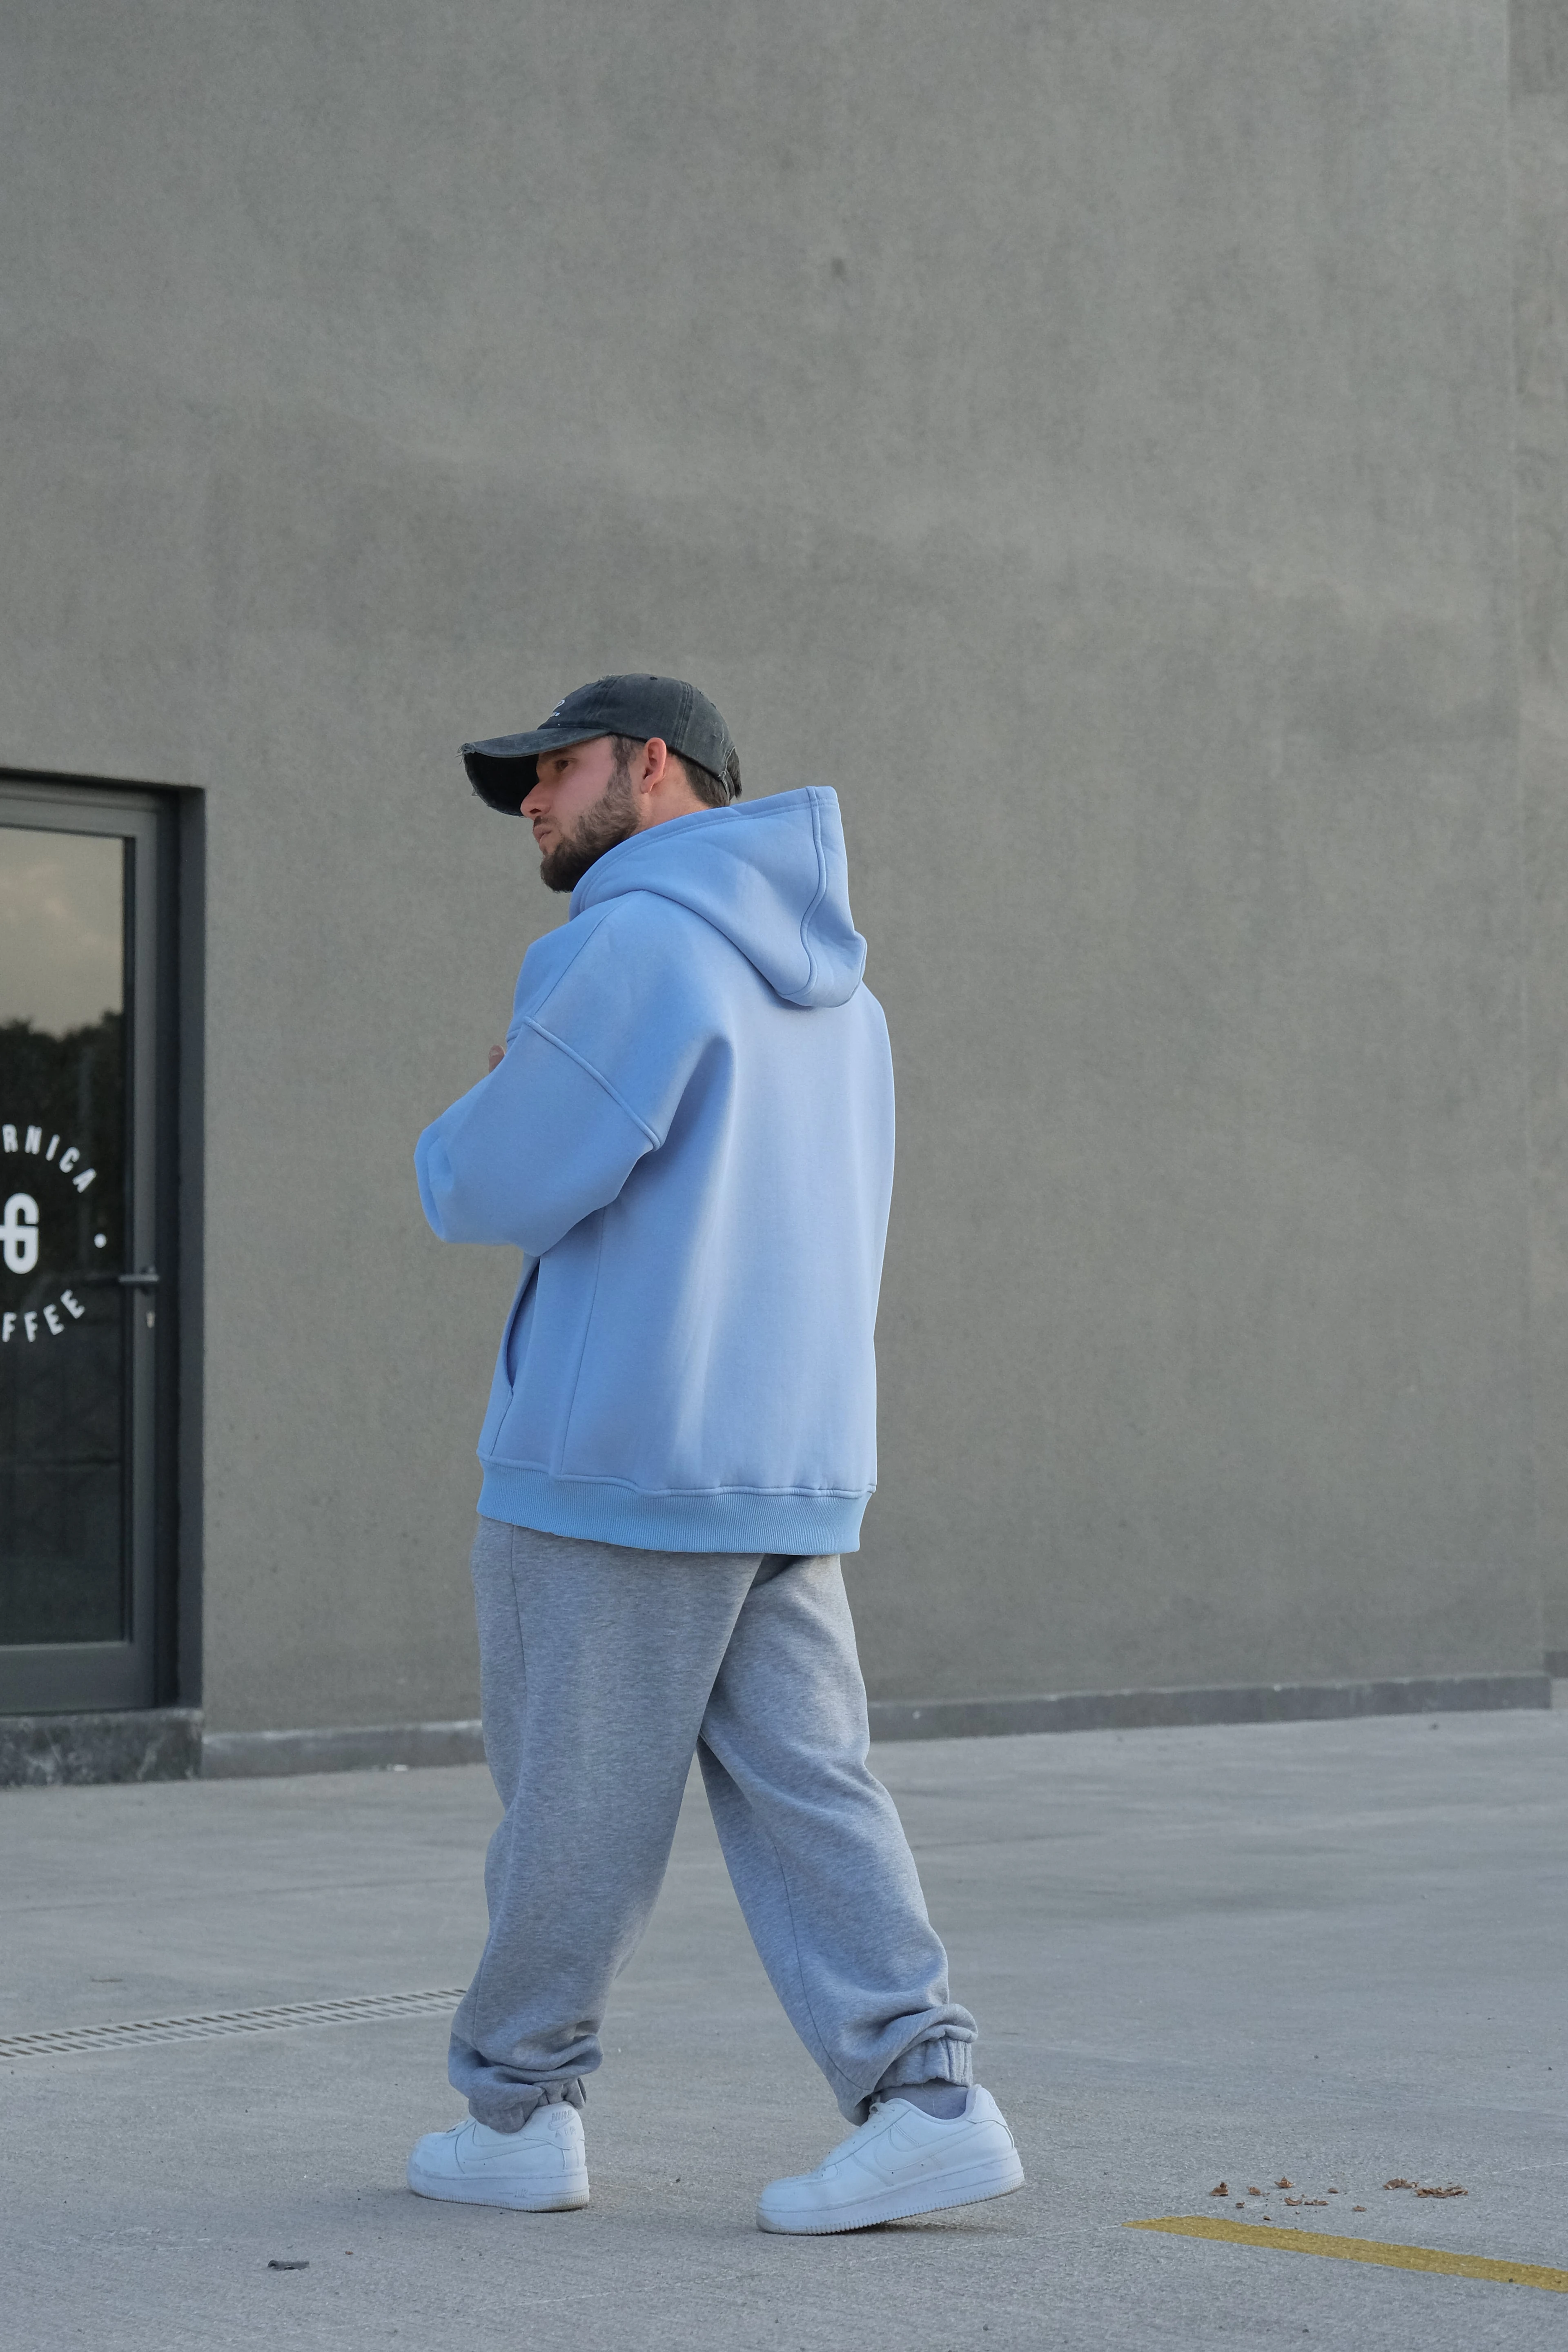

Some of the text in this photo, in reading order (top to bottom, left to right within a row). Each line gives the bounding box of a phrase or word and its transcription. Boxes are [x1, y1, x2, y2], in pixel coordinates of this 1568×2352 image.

[2, 1289, 85, 1343] FFEE
[551, 2109, 572, 2123] NIKE
[555, 2126, 576, 2138] AIR
